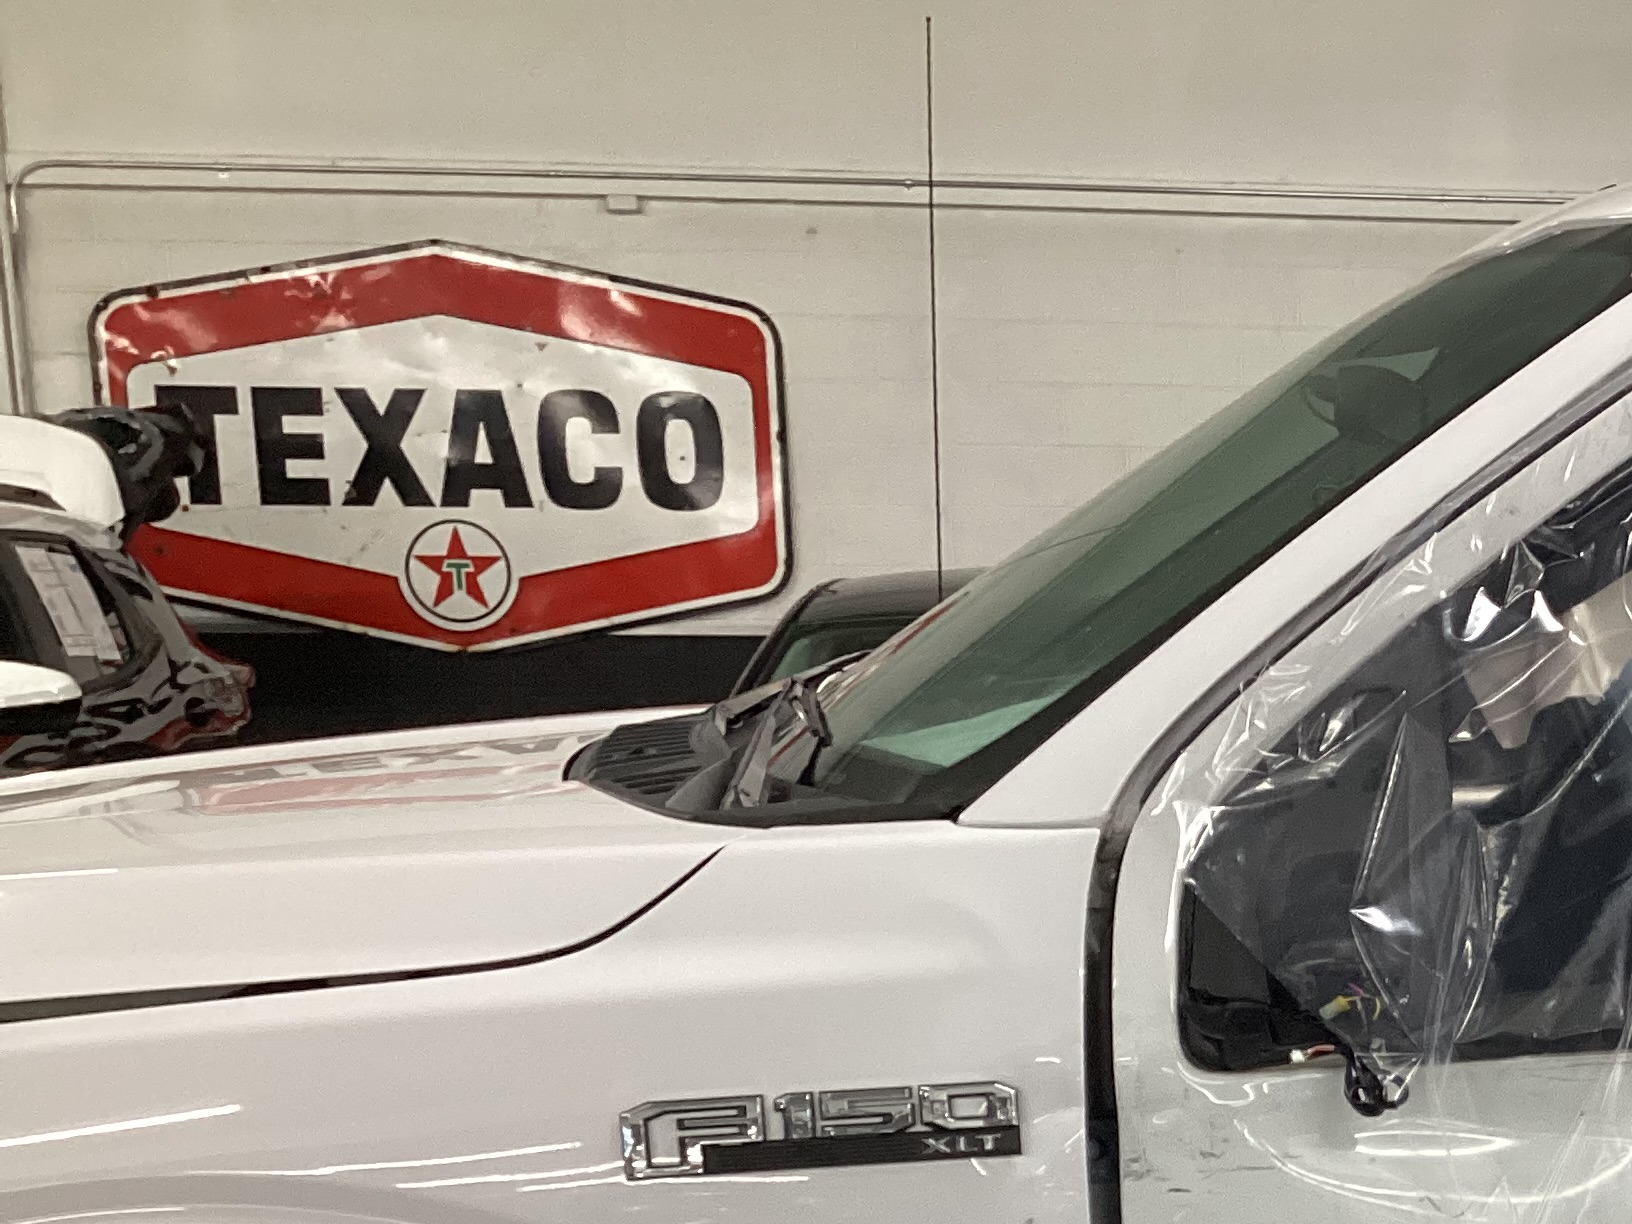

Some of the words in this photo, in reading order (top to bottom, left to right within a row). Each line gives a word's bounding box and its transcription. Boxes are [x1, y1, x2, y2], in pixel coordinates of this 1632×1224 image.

[154, 384, 724, 512] TEXACO
[446, 562, 471, 591] T
[921, 1132, 1003, 1155] XLT
